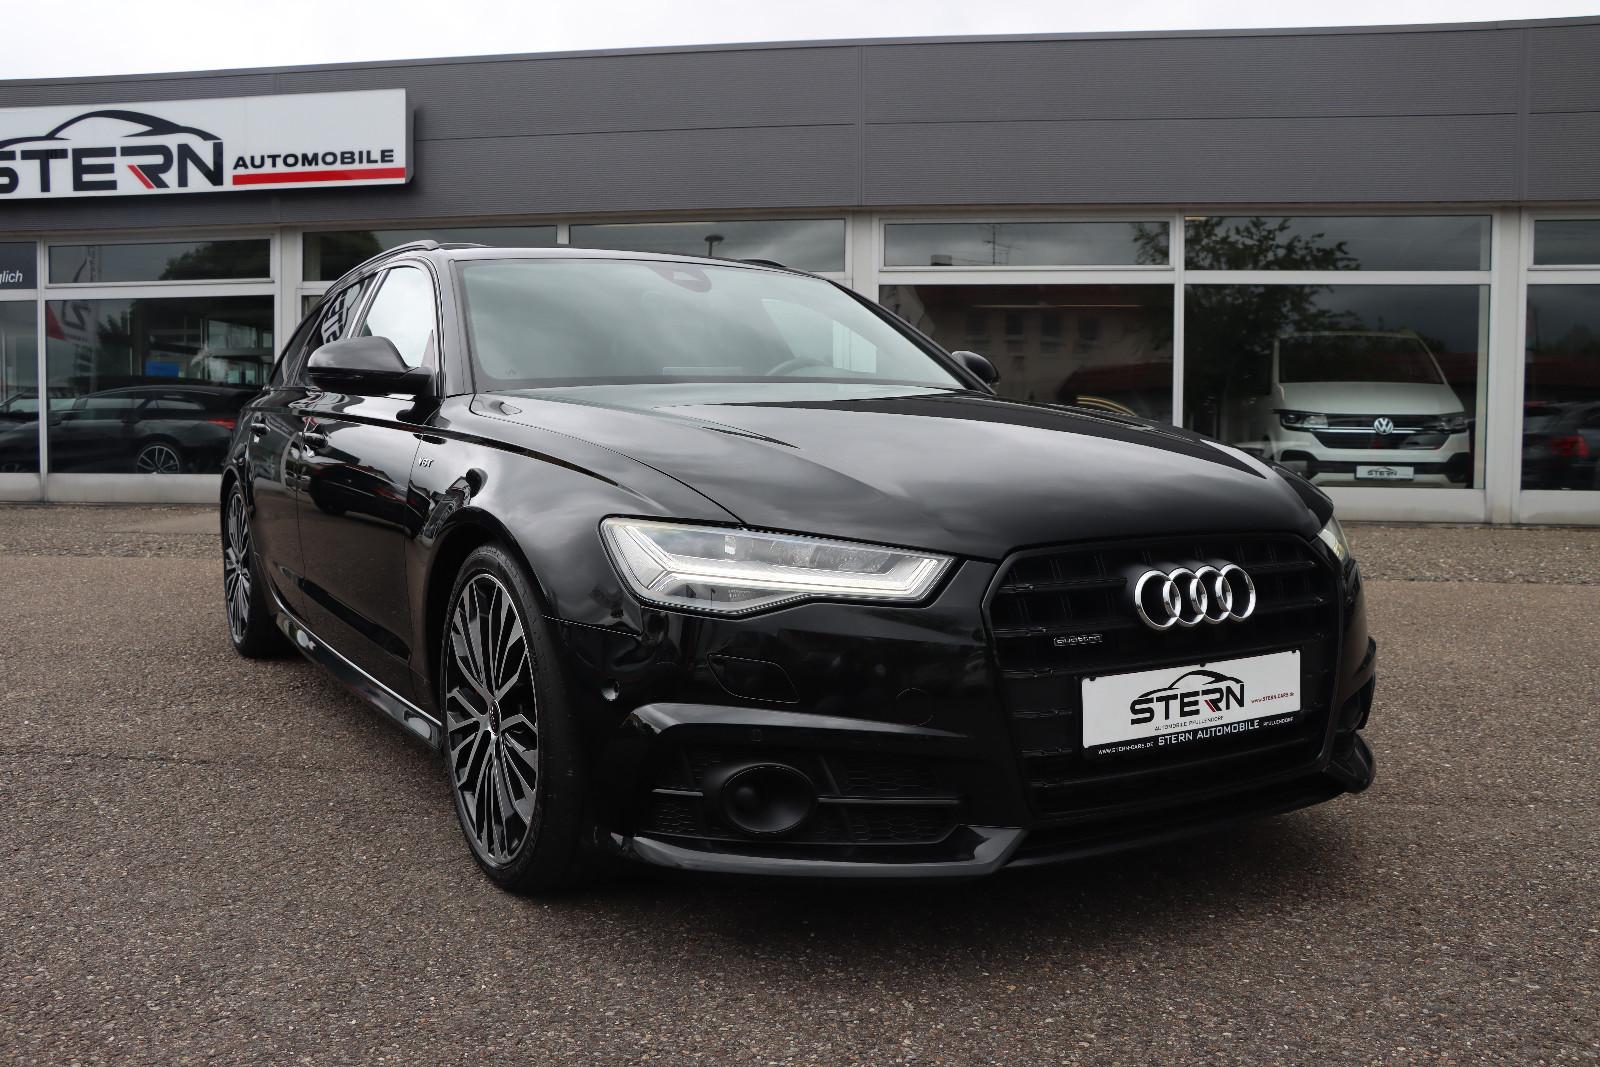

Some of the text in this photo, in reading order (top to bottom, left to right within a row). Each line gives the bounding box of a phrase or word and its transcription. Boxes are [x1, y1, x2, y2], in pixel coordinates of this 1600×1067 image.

[233, 148, 394, 170] AUTOMOBILE
[1130, 684, 1245, 725] STERN
[1158, 732, 1193, 746] STERN
[1197, 719, 1260, 739] AUTOMOBILE
